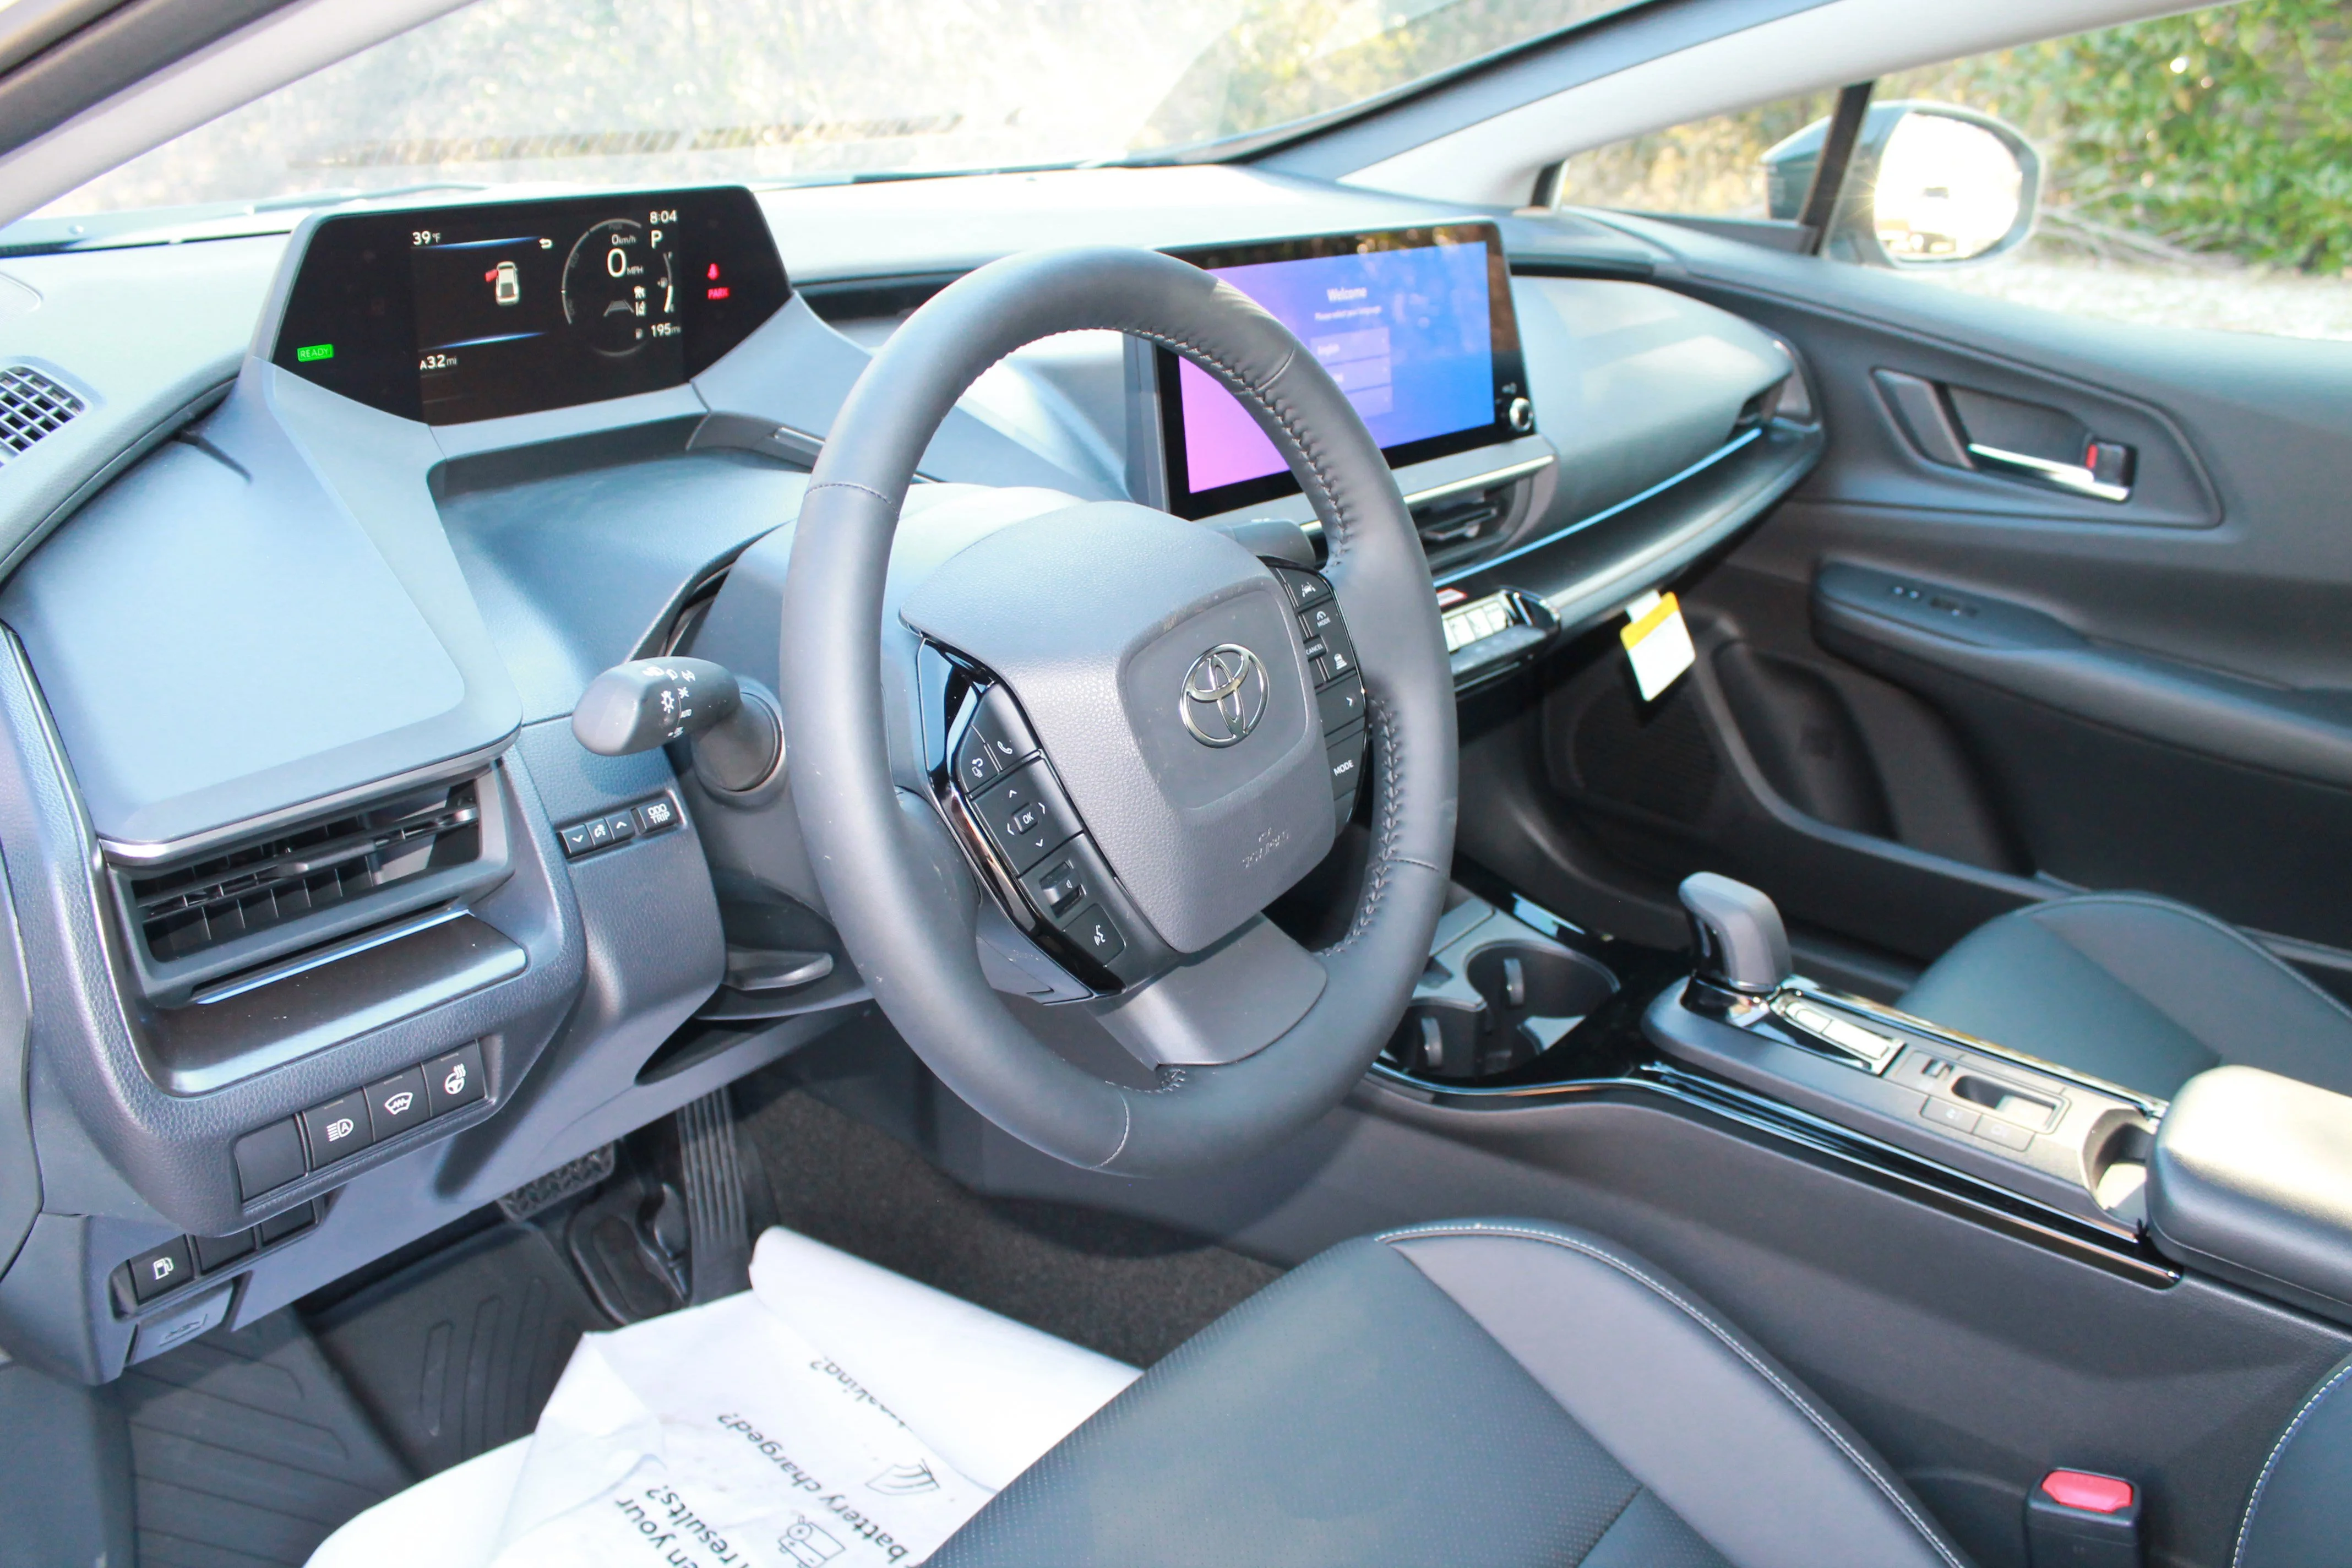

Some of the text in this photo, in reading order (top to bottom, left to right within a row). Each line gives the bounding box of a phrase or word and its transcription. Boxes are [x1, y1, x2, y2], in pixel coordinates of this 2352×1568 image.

[650, 210, 677, 225] 8:04
[651, 230, 663, 249] P
[1327, 287, 1368, 302] Welcome
[300, 347, 329, 358] READY
[1305, 643, 1323, 655] CANCEL
[1333, 759, 1354, 776] MODE
[647, 803, 668, 815] ODO
[650, 812, 671, 824] TRIP
[1022, 812, 1035, 824] OK
[717, 1413, 910, 1565] battery charged?
[614, 1498, 678, 1549] your
[645, 1484, 739, 1565] results?
